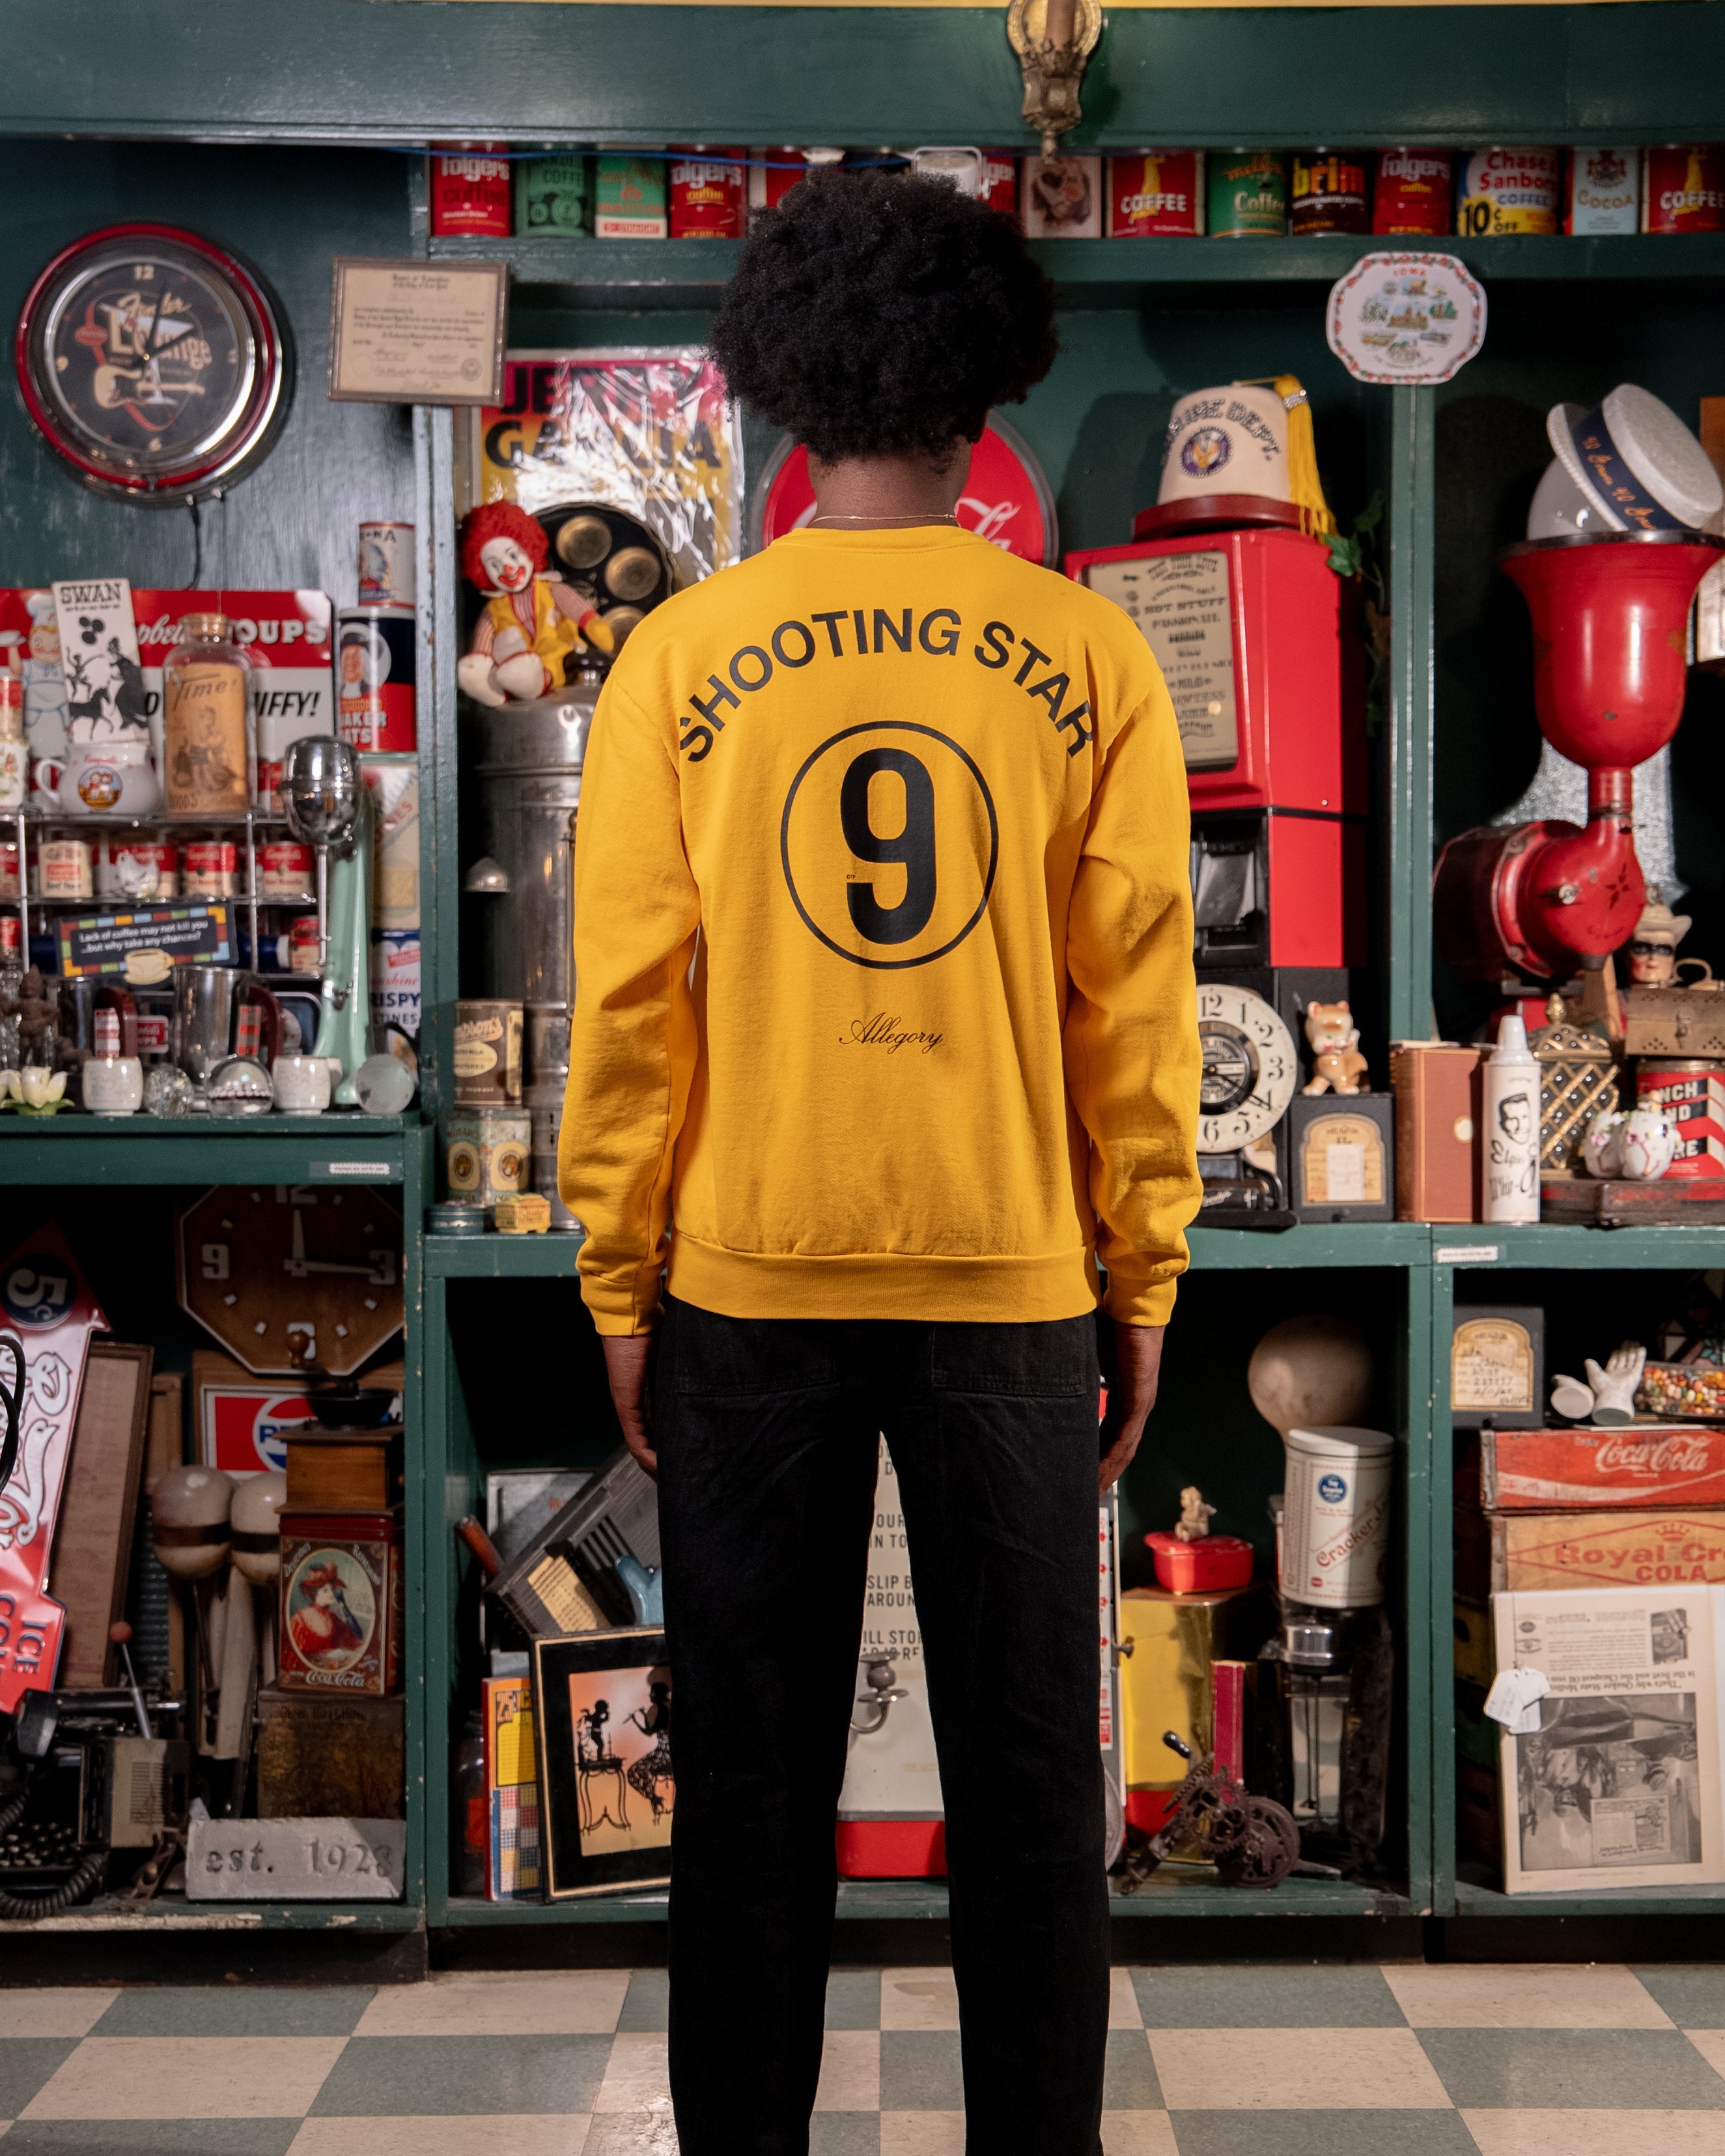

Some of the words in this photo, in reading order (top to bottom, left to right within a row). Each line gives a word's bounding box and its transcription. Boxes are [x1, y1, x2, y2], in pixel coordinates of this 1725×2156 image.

[672, 161, 742, 189] olgers
[1293, 156, 1365, 198] brim
[1120, 193, 1187, 214] COFFEE
[134, 265, 155, 281] 12
[484, 420, 722, 469] GACIA
[61, 583, 121, 605] SWAN
[234, 618, 328, 645] OUPS
[679, 607, 962, 763] SHOOTING
[974, 620, 1094, 758] STAR
[255, 692, 321, 717] IFFY!
[840, 746, 936, 945] 9
[79, 932, 100, 944] Lack
[102, 931, 111, 940] of
[112, 927, 140, 939] coffee
[140, 925, 160, 936] may
[160, 923, 176, 933] not
[176, 921, 190, 931] kill
[190, 920, 208, 931] you
[104, 940, 124, 953] why
[125, 938, 144, 949] take
[145, 936, 161, 947] any
[161, 930, 202, 944] chances?
[371, 992, 422, 1007] RISPY
[1201, 994, 1224, 1017] 12
[1240, 1002, 1247, 1025] 1
[839, 1011, 944, 1055] Allegory
[1258, 1024, 1274, 1047] 2
[1267, 1056, 1284, 1081] 3
[1251, 1088, 1273, 1112] 4
[1203, 1118, 1220, 1143] 6
[1233, 1110, 1250, 1136] 5
[201, 1243, 231, 1280] 9
[369, 1249, 397, 1285] 3
[1595, 1434, 1713, 1474] Coca-Cola
[1315, 1519, 1374, 1568] Cracker
[1554, 1544, 1665, 1570] Royal
[867, 1575, 899, 1590] SLIP
[1635, 1564, 1708, 1582] COLA
[866, 1592, 915, 1608] AROUN
[13, 1619, 47, 1675] ICE
[863, 1630, 884, 1645] ILL
[888, 1630, 921, 1645] STO
[305, 1670, 366, 1688] Coca-Cola
[1604, 1681, 1633, 1690] Quaker
[206, 1840, 275, 1873] est.
